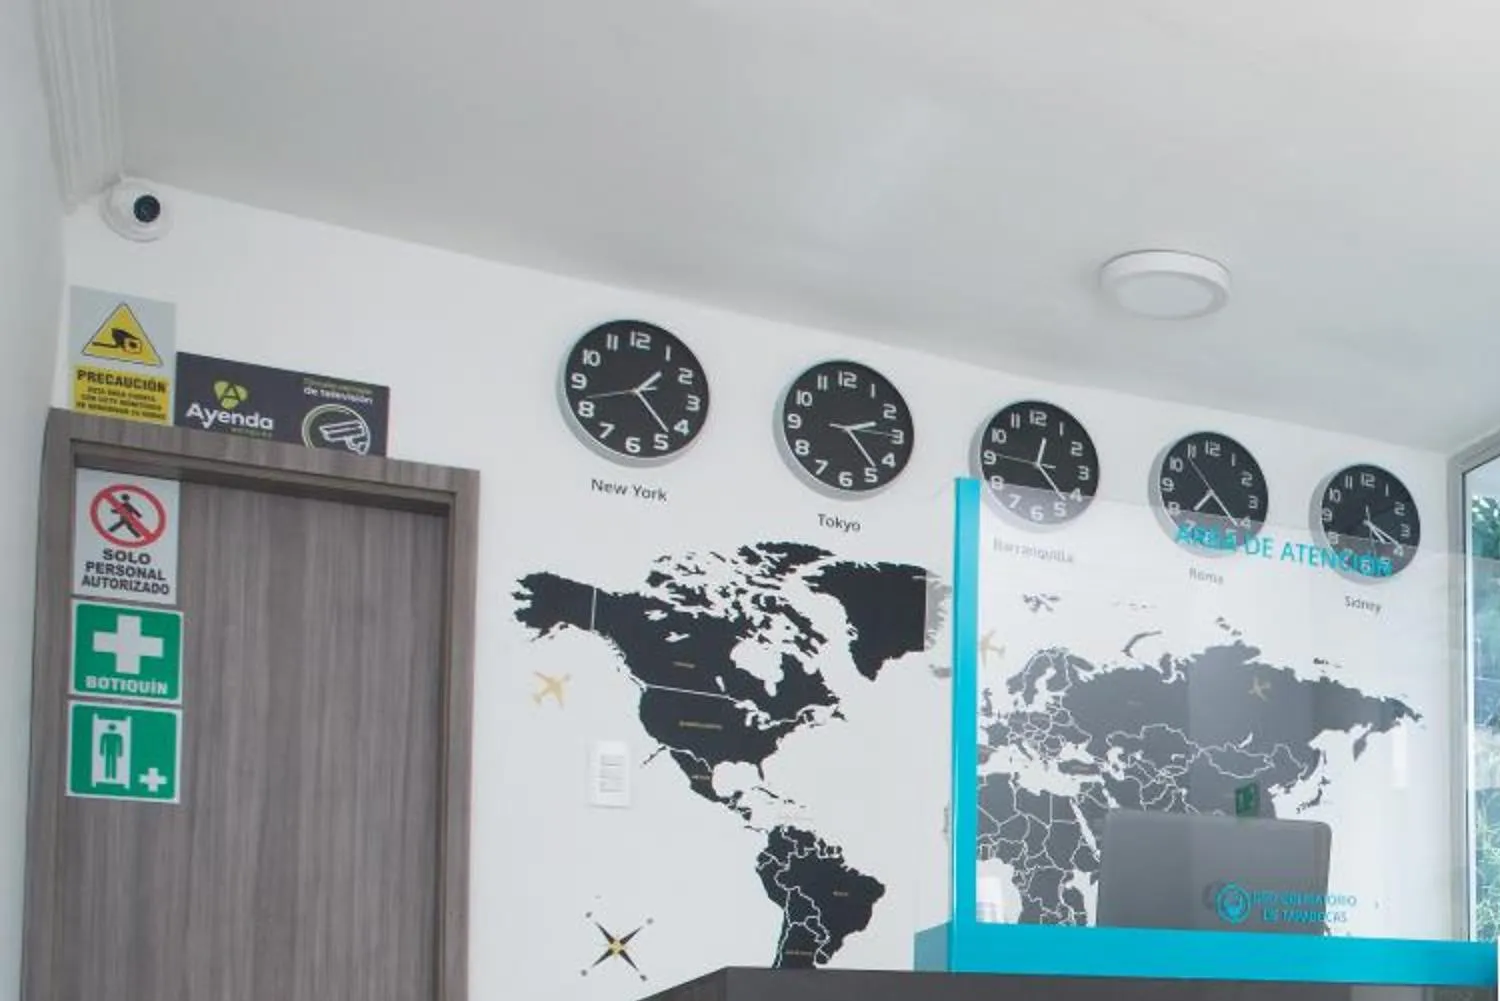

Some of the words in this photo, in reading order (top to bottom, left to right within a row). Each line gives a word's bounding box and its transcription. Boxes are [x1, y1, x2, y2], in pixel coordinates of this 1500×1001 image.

[606, 333, 618, 351] 11
[630, 330, 651, 351] 12
[583, 348, 600, 367] 10
[571, 372, 587, 389] 9
[677, 367, 694, 384] 2
[817, 374, 828, 391] 11
[838, 370, 857, 389] 12
[685, 393, 701, 411] 3
[796, 389, 813, 407] 10
[186, 403, 274, 429] Ayenda
[578, 400, 595, 418] 8
[883, 403, 897, 420] 2
[787, 413, 802, 429] 9
[1010, 412, 1021, 429] 11
[1029, 410, 1048, 427] 12
[600, 421, 615, 439] 7
[673, 419, 690, 436] 4
[625, 436, 641, 453] 6
[653, 433, 669, 450] 5
[891, 429, 904, 445] 3
[991, 428, 1007, 445] 10
[794, 439, 810, 456] 8
[1071, 441, 1084, 457] 2
[1187, 444, 1197, 459] 11
[1205, 440, 1221, 457] 12
[881, 452, 896, 468] 4
[983, 450, 997, 466] 9
[1169, 456, 1183, 472] 10
[815, 459, 829, 475] 7
[864, 467, 878, 483] 5
[1077, 465, 1090, 481] 3
[839, 471, 853, 487] 6
[990, 475, 1004, 490] 8
[1162, 477, 1175, 493] 9
[1241, 471, 1253, 487] 2
[1345, 474, 1353, 489] 11
[1360, 472, 1375, 488] 12
[591, 478, 628, 495] New
[631, 483, 668, 502] York
[1070, 488, 1083, 503] 4
[1329, 487, 1341, 504] 10
[1008, 494, 1022, 509] 7
[1053, 502, 1067, 518] 5
[1248, 494, 1259, 510] 3
[1394, 501, 1405, 517] 2
[1030, 506, 1044, 521] 6
[1321, 508, 1333, 522] 9
[817, 513, 862, 533] Tokyo
[1240, 516, 1251, 530] 4
[1400, 523, 1410, 538] 3
[1244, 533, 1273, 559] DE
[102, 548, 151, 565] SOLO
[85, 561, 166, 581] PERSONAL
[81, 575, 170, 596] AUTORIZADO
[1344, 596, 1382, 614] Sidney
[85, 674, 168, 695] BOTIQUÍN
